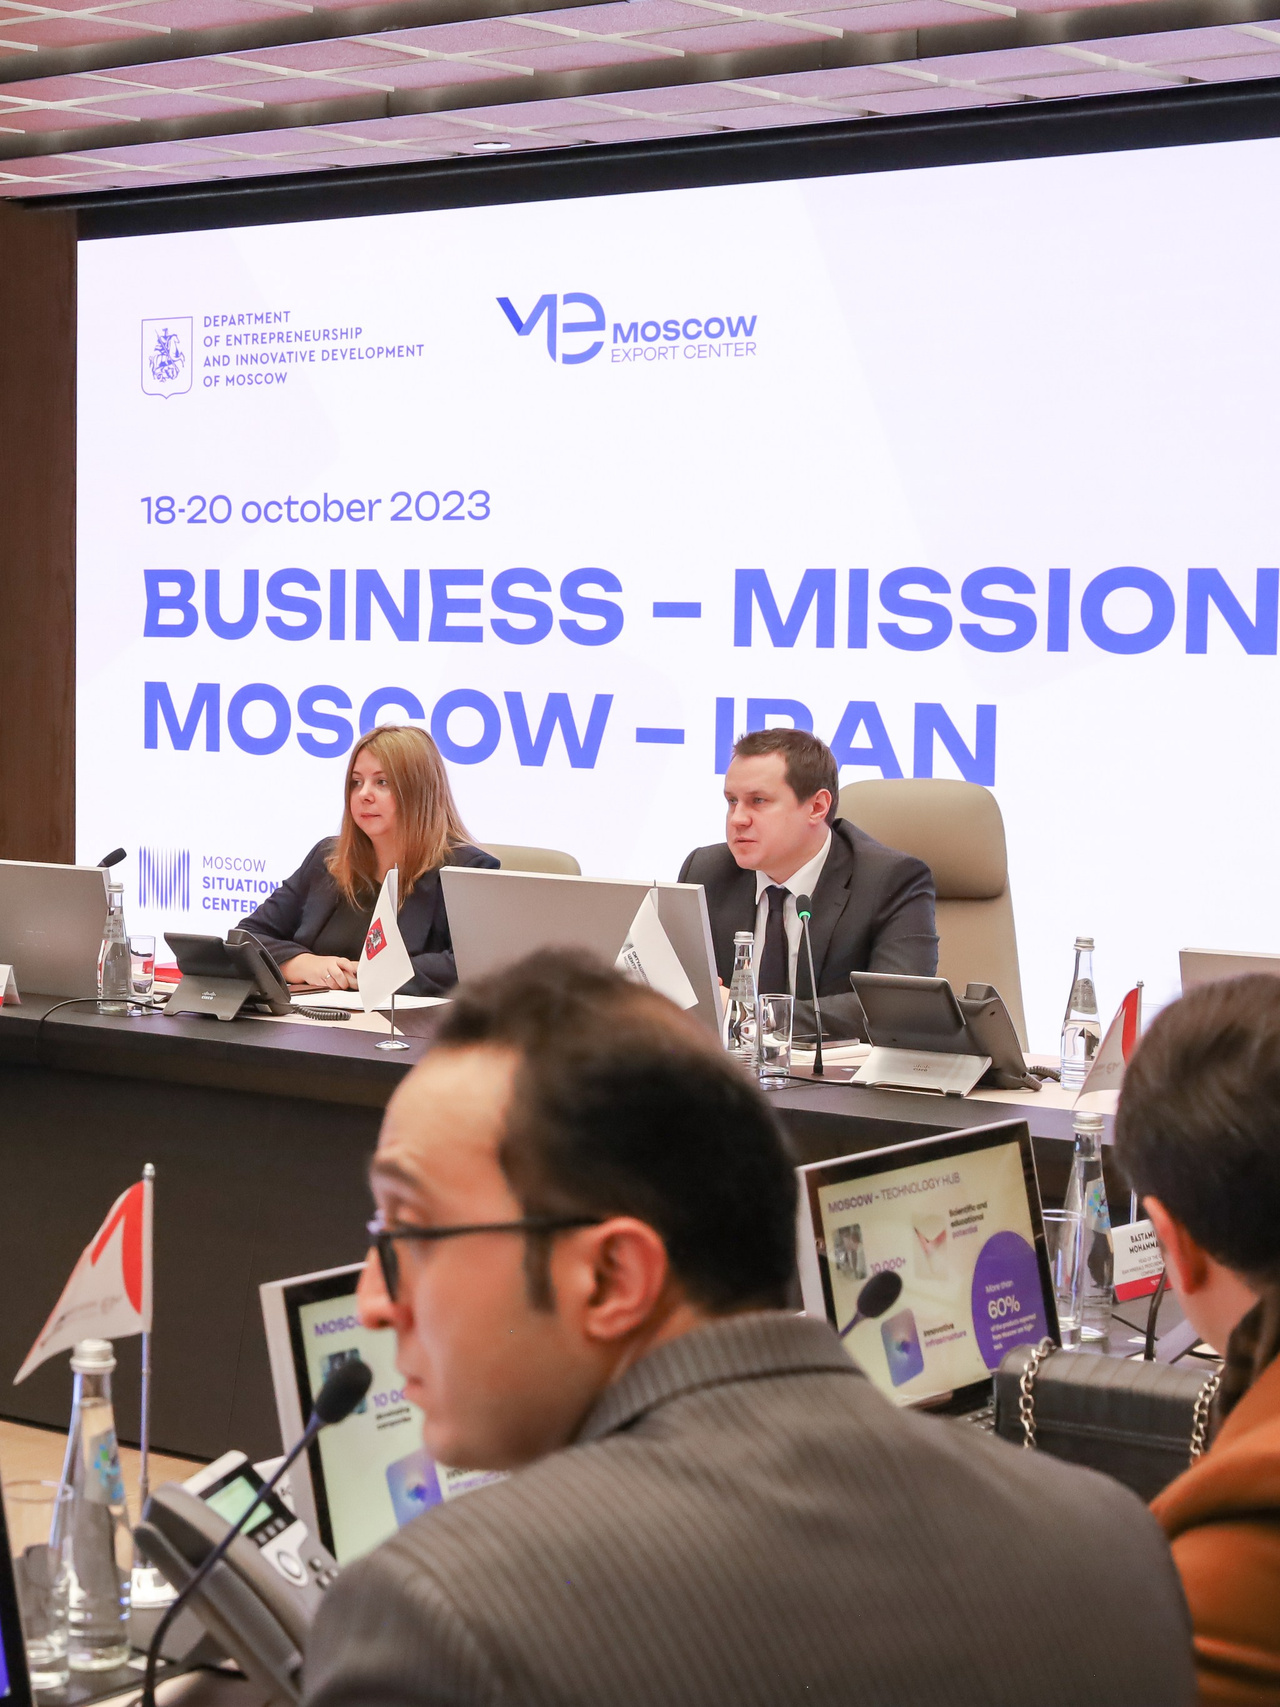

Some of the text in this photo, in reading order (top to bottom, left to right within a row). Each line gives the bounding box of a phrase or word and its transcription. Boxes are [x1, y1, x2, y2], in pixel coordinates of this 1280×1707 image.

[203, 310, 291, 328] DEPARTMENT
[612, 315, 758, 344] MOSCOW
[203, 326, 363, 348] OF ENTREPRENEURSHIP
[203, 344, 424, 367] AND INNOVATIVE DEVELOPMENT
[611, 342, 757, 363] EXPORT CENTER
[203, 372, 288, 387] OF MOSCOW
[140, 489, 491, 524] 18-20 october 2023
[143, 567, 624, 646] BUSINESS
[733, 566, 1280, 655] MISSION
[202, 855, 266, 872] MOSCOW
[202, 876, 279, 894] SITUATION
[202, 897, 258, 913] CENTER
[828, 1193, 873, 1213] MOSCOW
[880, 1178, 940, 1201] TECHNOLOGY
[942, 1172, 961, 1186] HUB
[988, 1294, 1020, 1319] 60%
[314, 1315, 361, 1337] MOSC
